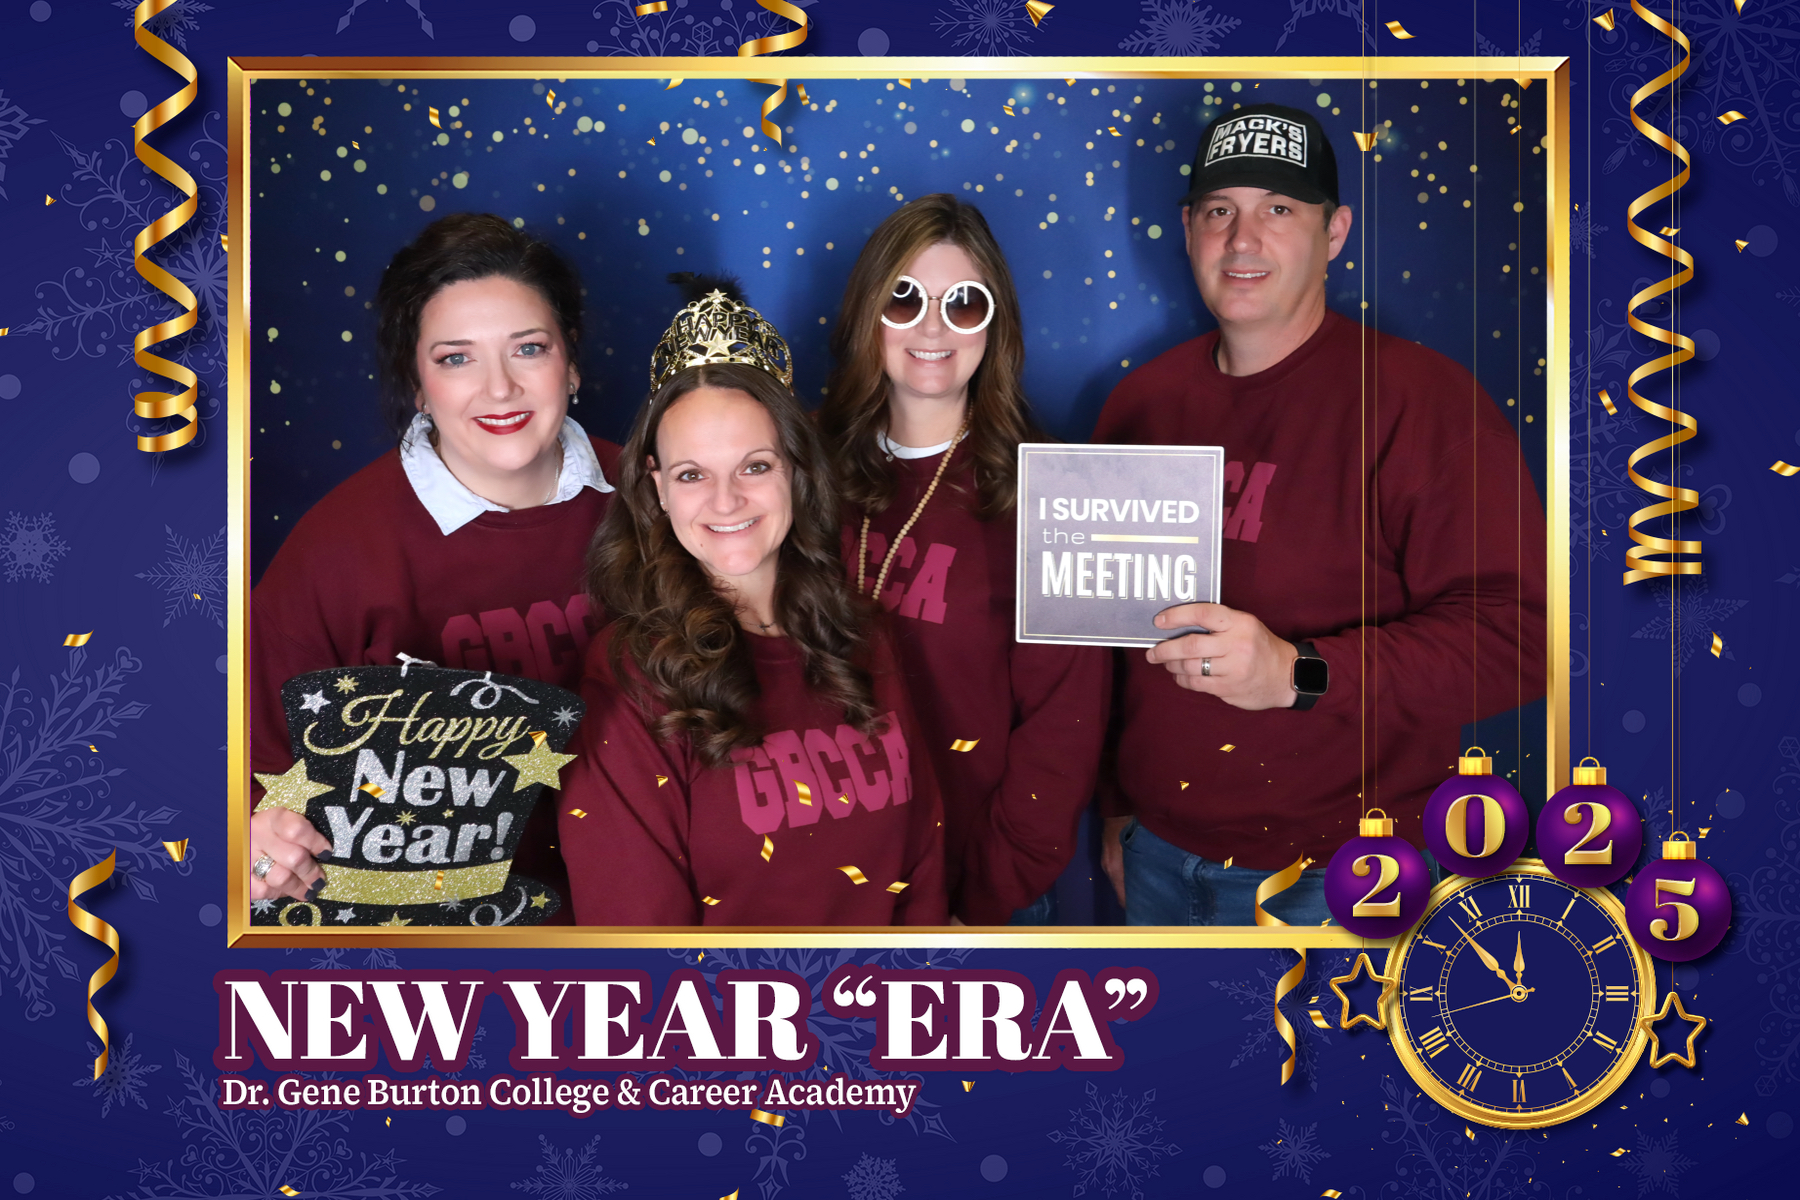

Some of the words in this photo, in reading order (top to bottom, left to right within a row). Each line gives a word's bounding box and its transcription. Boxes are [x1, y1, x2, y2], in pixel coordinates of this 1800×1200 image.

[1208, 131, 1303, 161] FRYERS
[1213, 118, 1303, 143] MACK'S
[676, 312, 760, 336] HAPPY
[717, 325, 779, 360] YEAR
[1039, 498, 1047, 520] I
[1052, 498, 1200, 524] SURVIVED
[1042, 528, 1085, 544] the
[1041, 551, 1197, 602] MEETING
[303, 689, 530, 760] Happy
[350, 749, 506, 807] New
[324, 806, 514, 864] Year!
